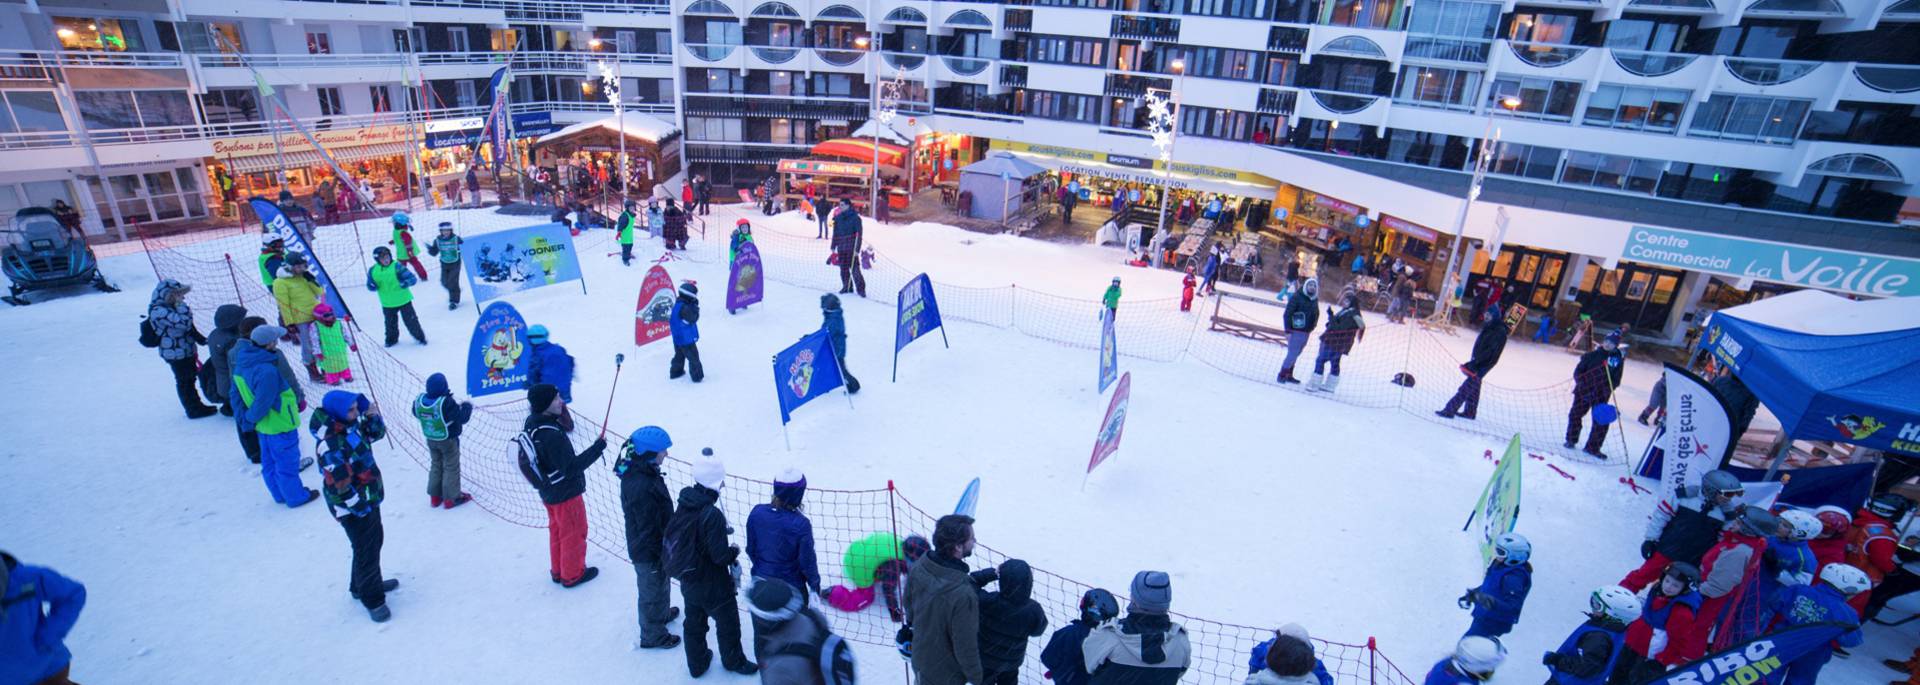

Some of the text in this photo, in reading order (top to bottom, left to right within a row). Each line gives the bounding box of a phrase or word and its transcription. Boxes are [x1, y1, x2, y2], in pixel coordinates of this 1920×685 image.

[213, 140, 256, 154] Bonbons
[257, 139, 274, 151] par
[434, 137, 466, 147] LOCATION
[1060, 165, 1100, 176] LOCATION
[1104, 171, 1130, 180] VENTE
[1161, 161, 1237, 179] aouskigliss.com
[1634, 230, 1689, 248] Centre
[521, 243, 566, 257] YOONER
[1629, 244, 1732, 270] Commercial
[1744, 249, 1909, 296] La Voile
[1898, 422, 1920, 443] H
